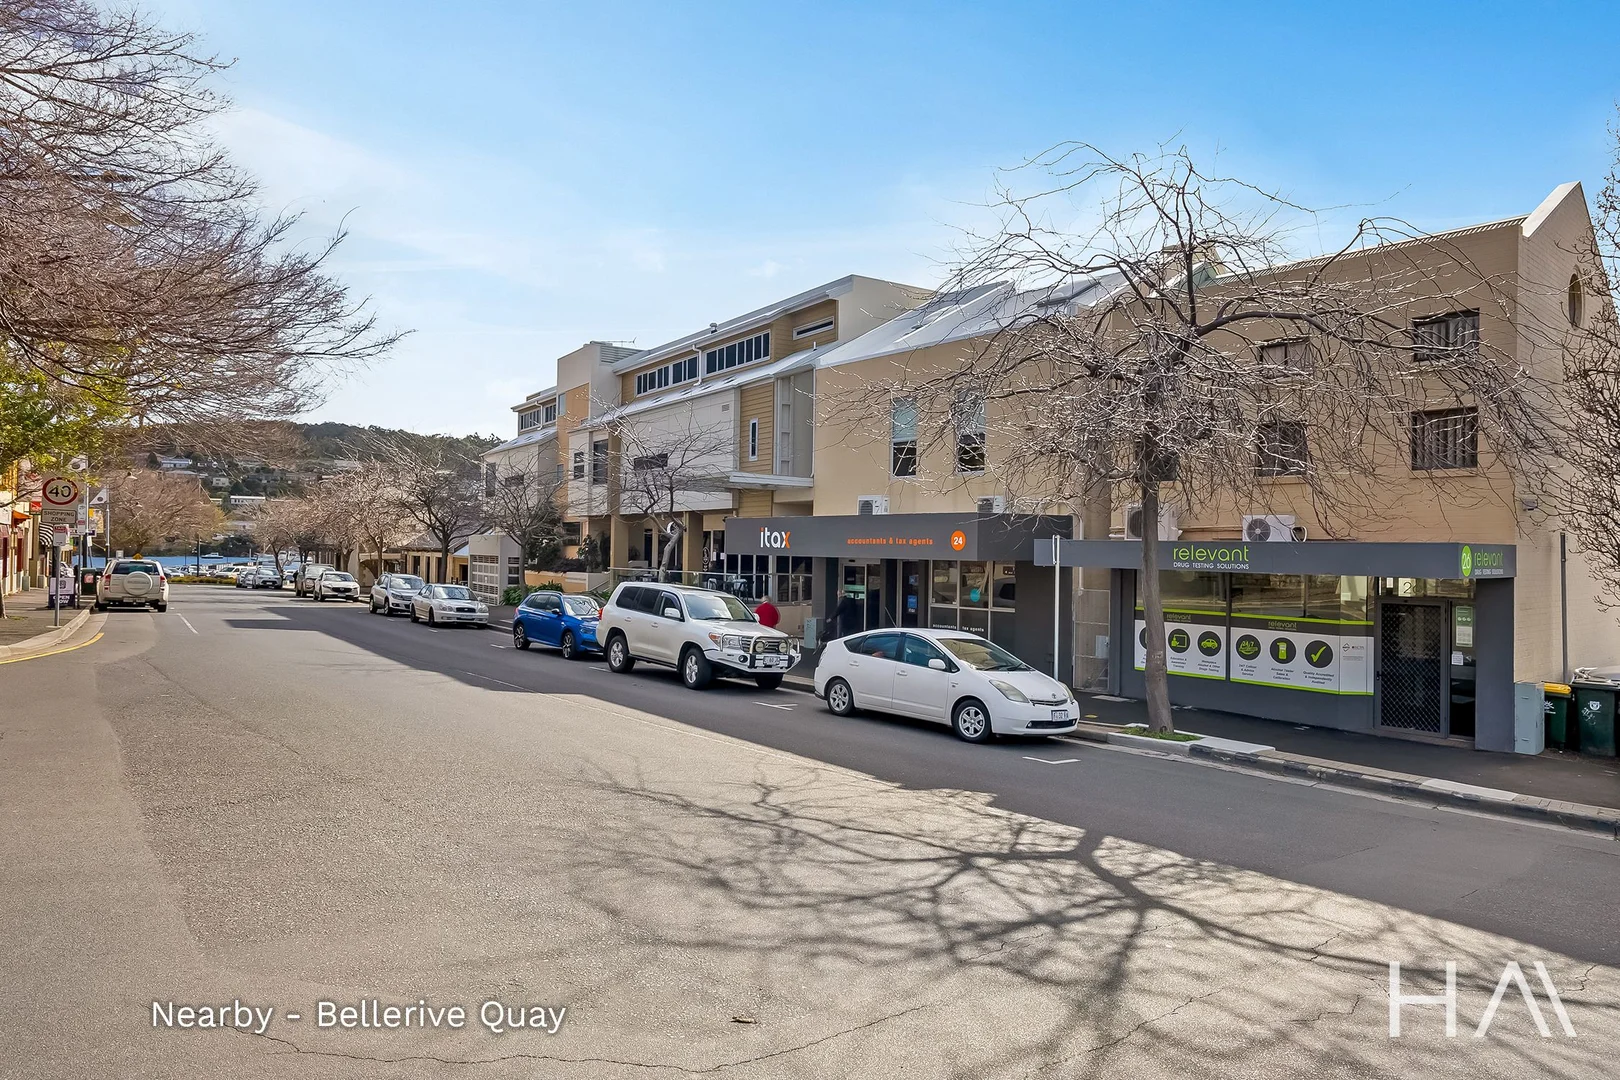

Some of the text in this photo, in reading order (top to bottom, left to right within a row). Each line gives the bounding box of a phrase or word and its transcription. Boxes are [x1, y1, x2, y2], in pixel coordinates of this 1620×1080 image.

[48, 485, 72, 497] 40
[760, 526, 791, 549] itax
[908, 538, 934, 546] agents
[953, 536, 963, 545] 24
[1173, 544, 1249, 561] relevant
[1474, 549, 1504, 567] relevant
[1173, 561, 1190, 569] DRUG
[1462, 553, 1472, 570] 26
